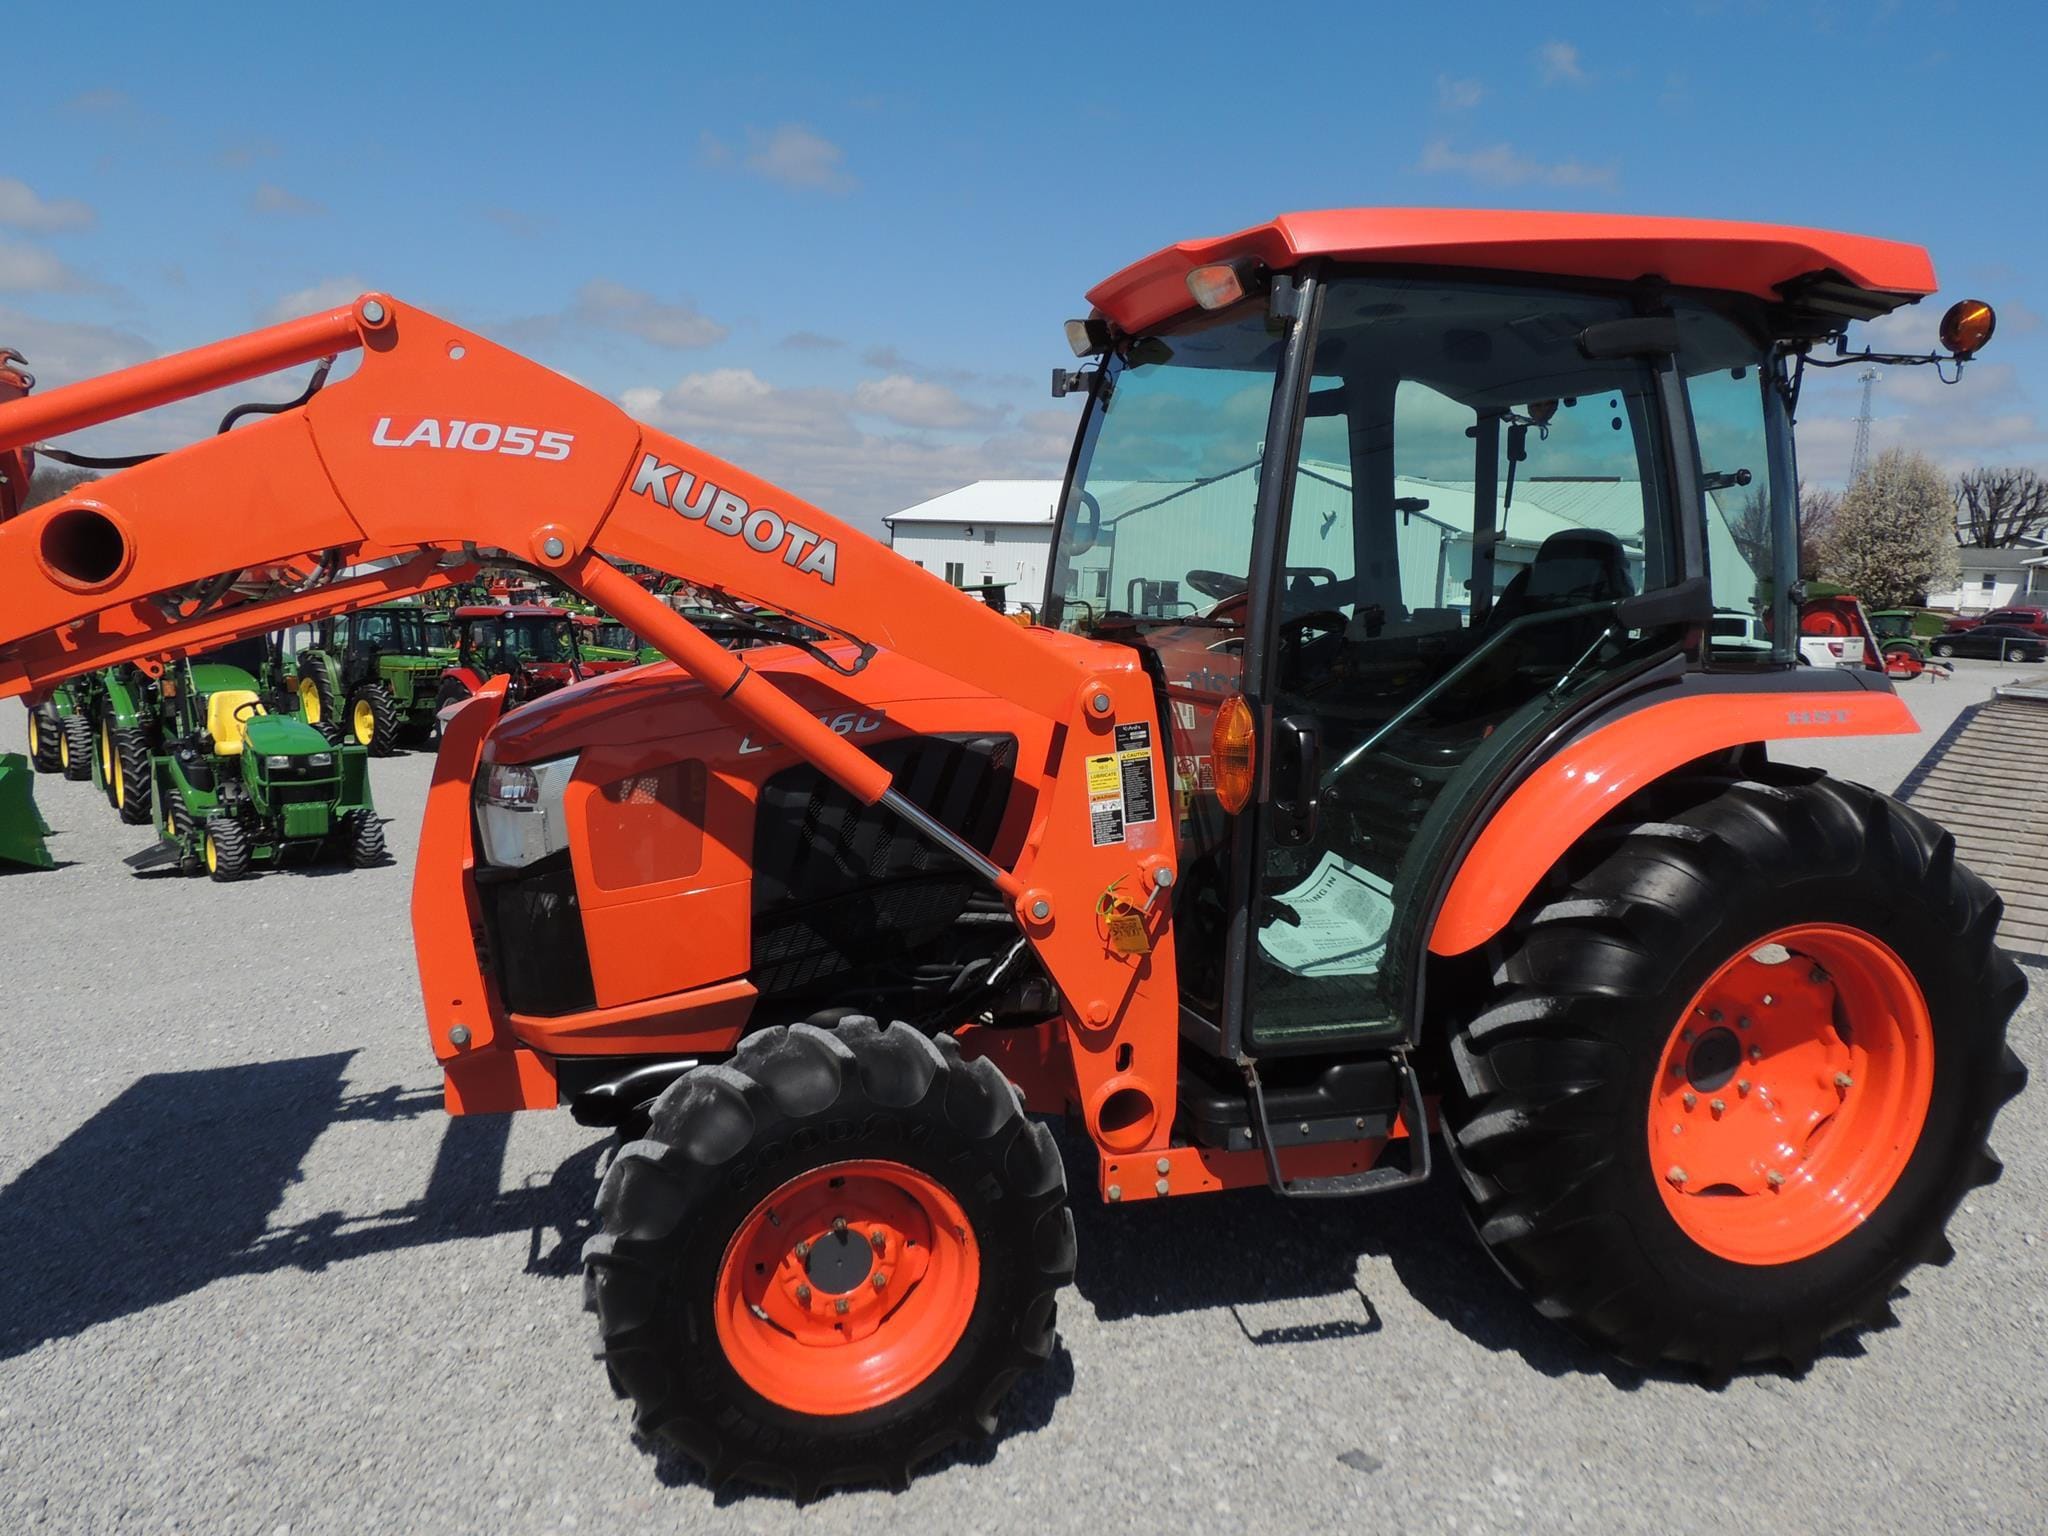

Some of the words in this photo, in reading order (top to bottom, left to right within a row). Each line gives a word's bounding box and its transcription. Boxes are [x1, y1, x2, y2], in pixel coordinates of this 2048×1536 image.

[372, 417, 574, 461] LA1055
[631, 454, 837, 585] KUBOTA
[1786, 710, 1850, 725] HST
